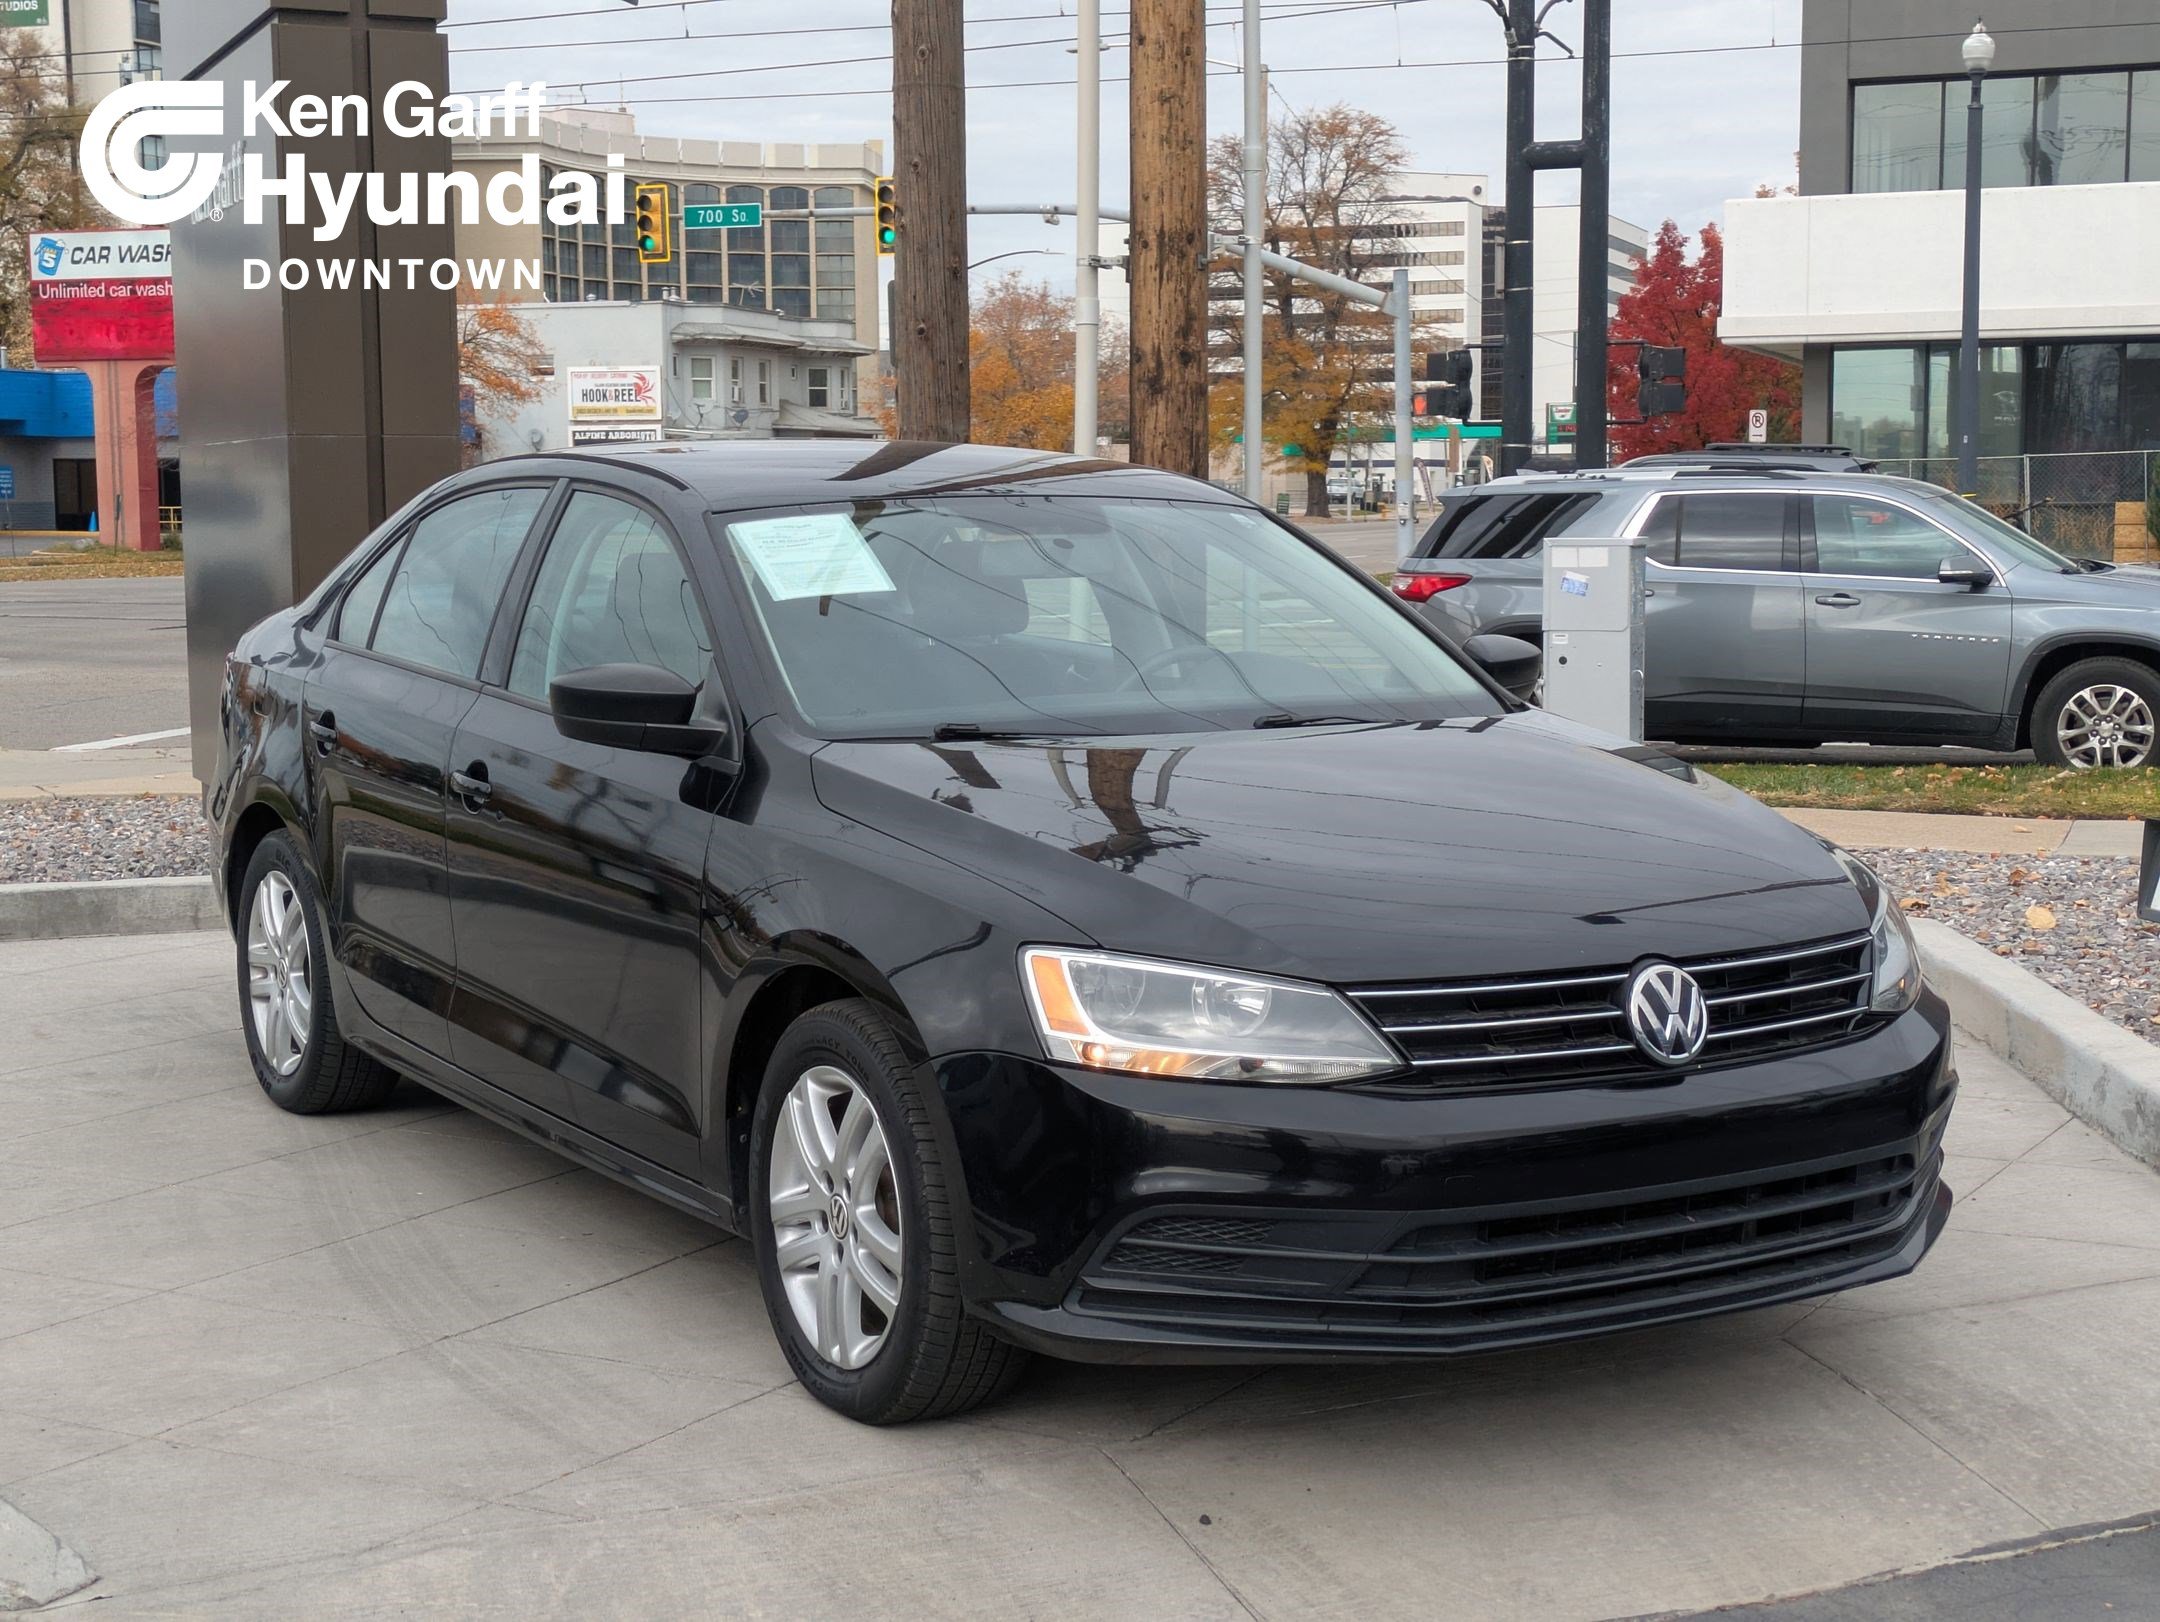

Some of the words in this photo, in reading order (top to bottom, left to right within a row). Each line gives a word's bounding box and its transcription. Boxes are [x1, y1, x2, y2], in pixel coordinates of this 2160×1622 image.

[697, 209, 723, 224] 700
[70, 246, 111, 265] CAR
[39, 282, 105, 299] Unlimited
[109, 286, 132, 297] car
[574, 431, 606, 440] ALPINE
